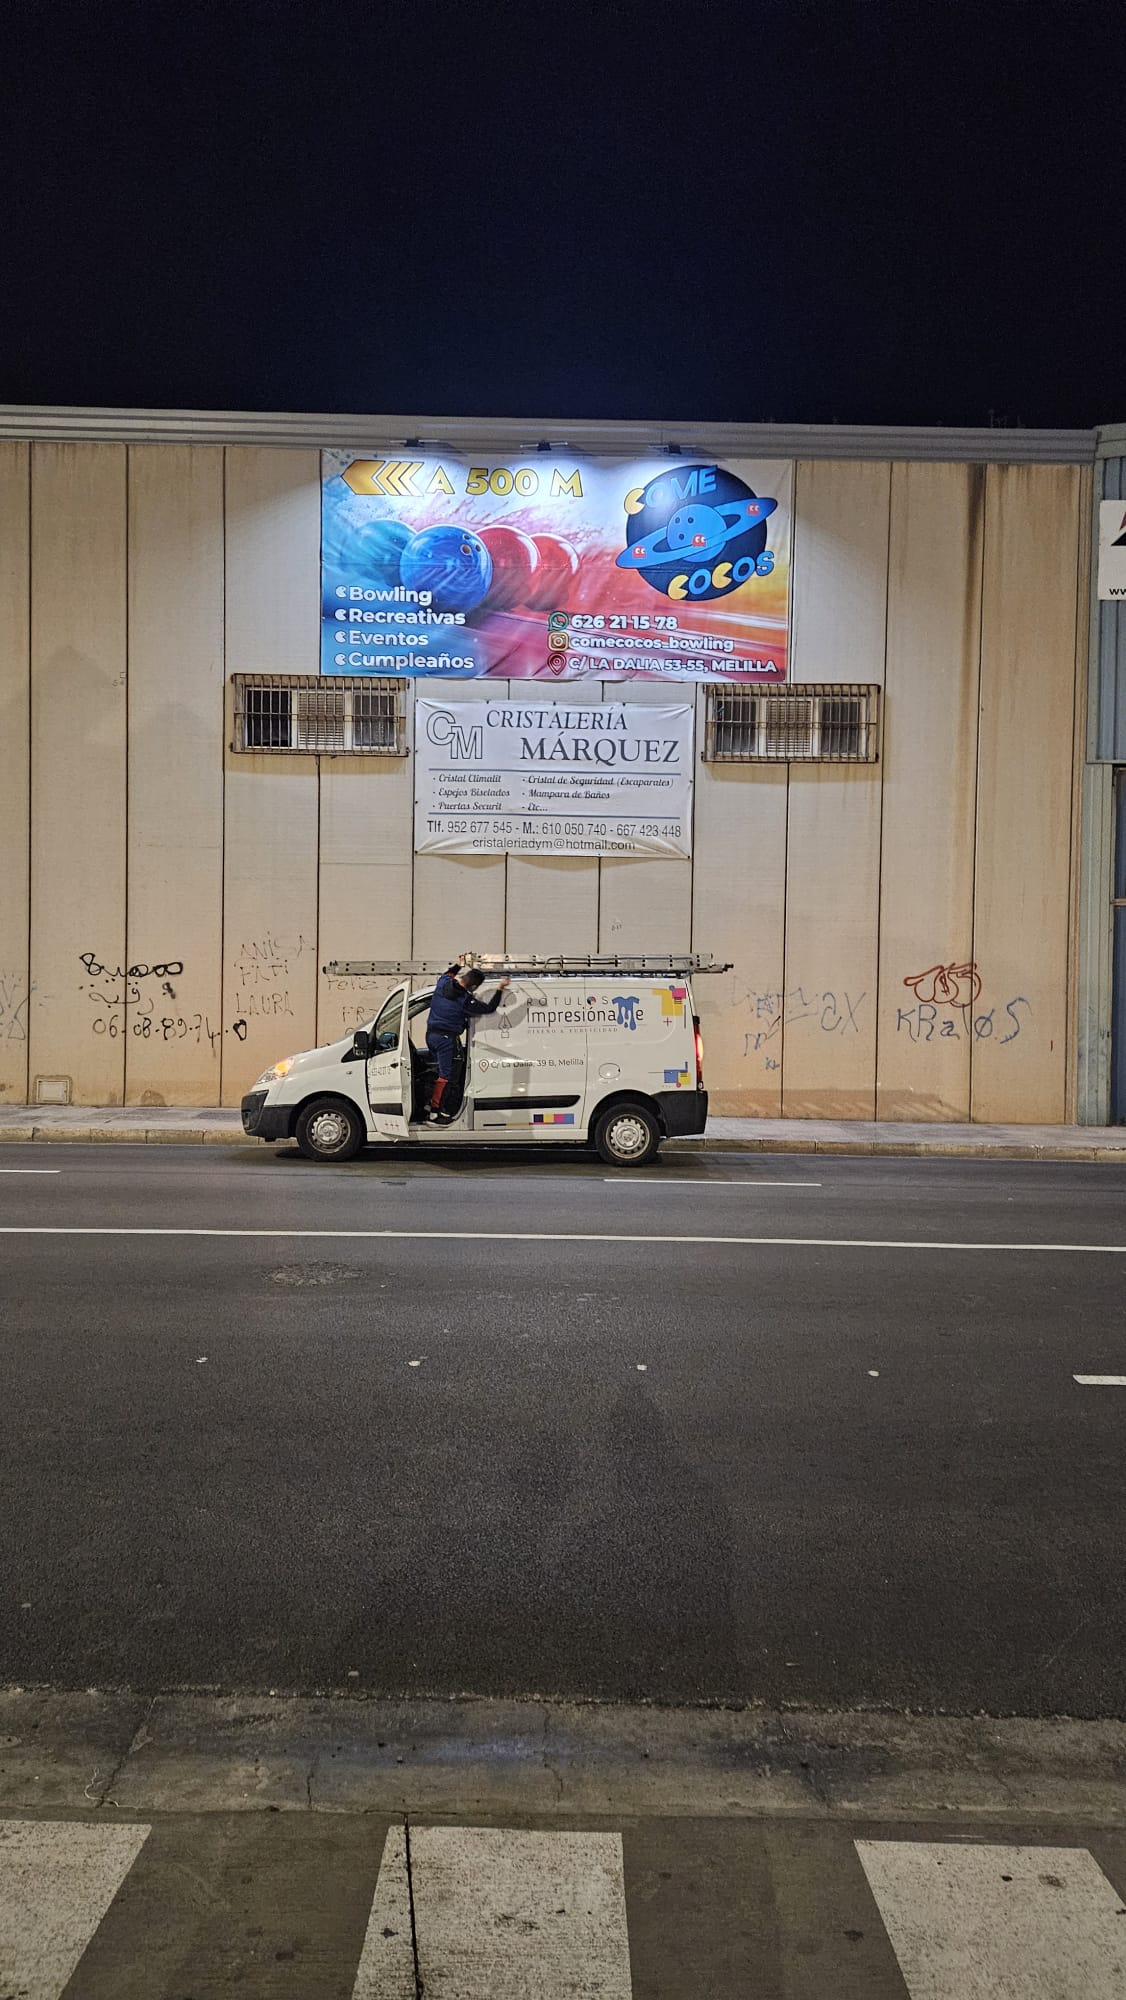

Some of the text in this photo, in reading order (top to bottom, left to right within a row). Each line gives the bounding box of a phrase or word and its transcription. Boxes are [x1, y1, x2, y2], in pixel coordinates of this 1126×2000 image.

[425, 466, 583, 497] A 500 M
[624, 466, 717, 515] COME
[668, 551, 774, 600] COCOS
[349, 586, 432, 606] Bowling
[349, 608, 466, 625] Recreativas
[571, 614, 678, 630] 626 21 15 78
[349, 630, 429, 646] Eventos
[570, 636, 734, 652] comecocos_bowling
[348, 652, 474, 670] Cumpleaños
[589, 658, 611, 670] LA
[613, 658, 663, 671] DALIA
[664, 659, 708, 673] 53-55,
[711, 660, 777, 673] MELILLA
[486, 706, 629, 730] CRISTALERÍA
[520, 731, 681, 766] MÁRQUEZ
[439, 773, 502, 783] Cristal Climalit
[528, 775, 556, 784] Cristal
[557, 776, 568, 784] de
[569, 776, 614, 786] Seguridad
[439, 787, 510, 798] Espejos Biselados
[528, 789, 610, 800] Mampara de Baños
[438, 801, 502, 811] Puertas Securit
[427, 820, 444, 833] Tlf.
[447, 821, 468, 833] 952
[470, 821, 490, 833] 677
[493, 821, 513, 834] 545
[542, 822, 562, 835] 610
[565, 823, 584, 835] 050
[588, 823, 607, 836] 740
[617, 824, 636, 836] 667
[640, 824, 659, 837] 423
[661, 825, 681, 837] 448
[473, 837, 635, 850] cristaleriadym@hotmail.com
[559, 1058, 584, 1066] Melilla
